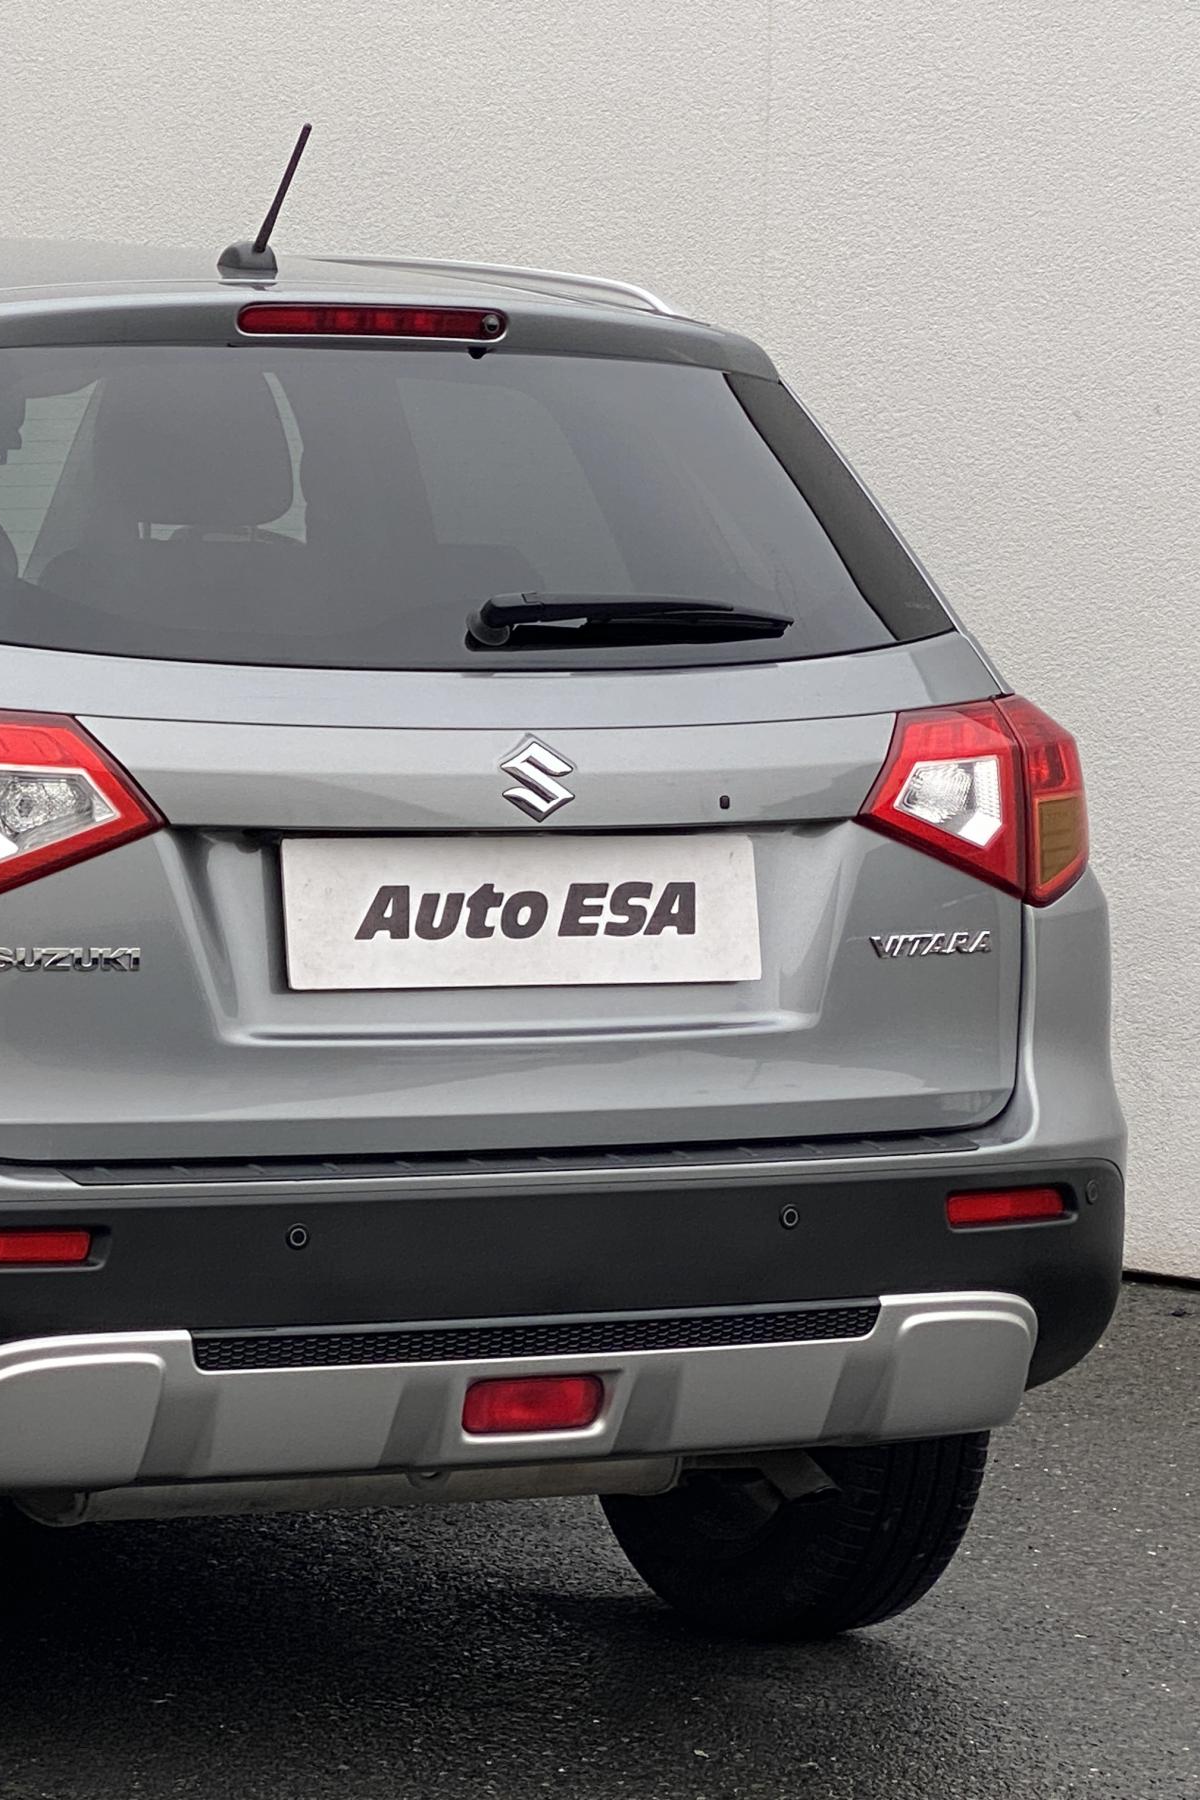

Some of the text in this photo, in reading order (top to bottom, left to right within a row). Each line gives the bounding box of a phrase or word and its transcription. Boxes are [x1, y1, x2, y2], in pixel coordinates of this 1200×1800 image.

[354, 881, 696, 940] Auto ESA
[869, 930, 991, 958] VITARA
